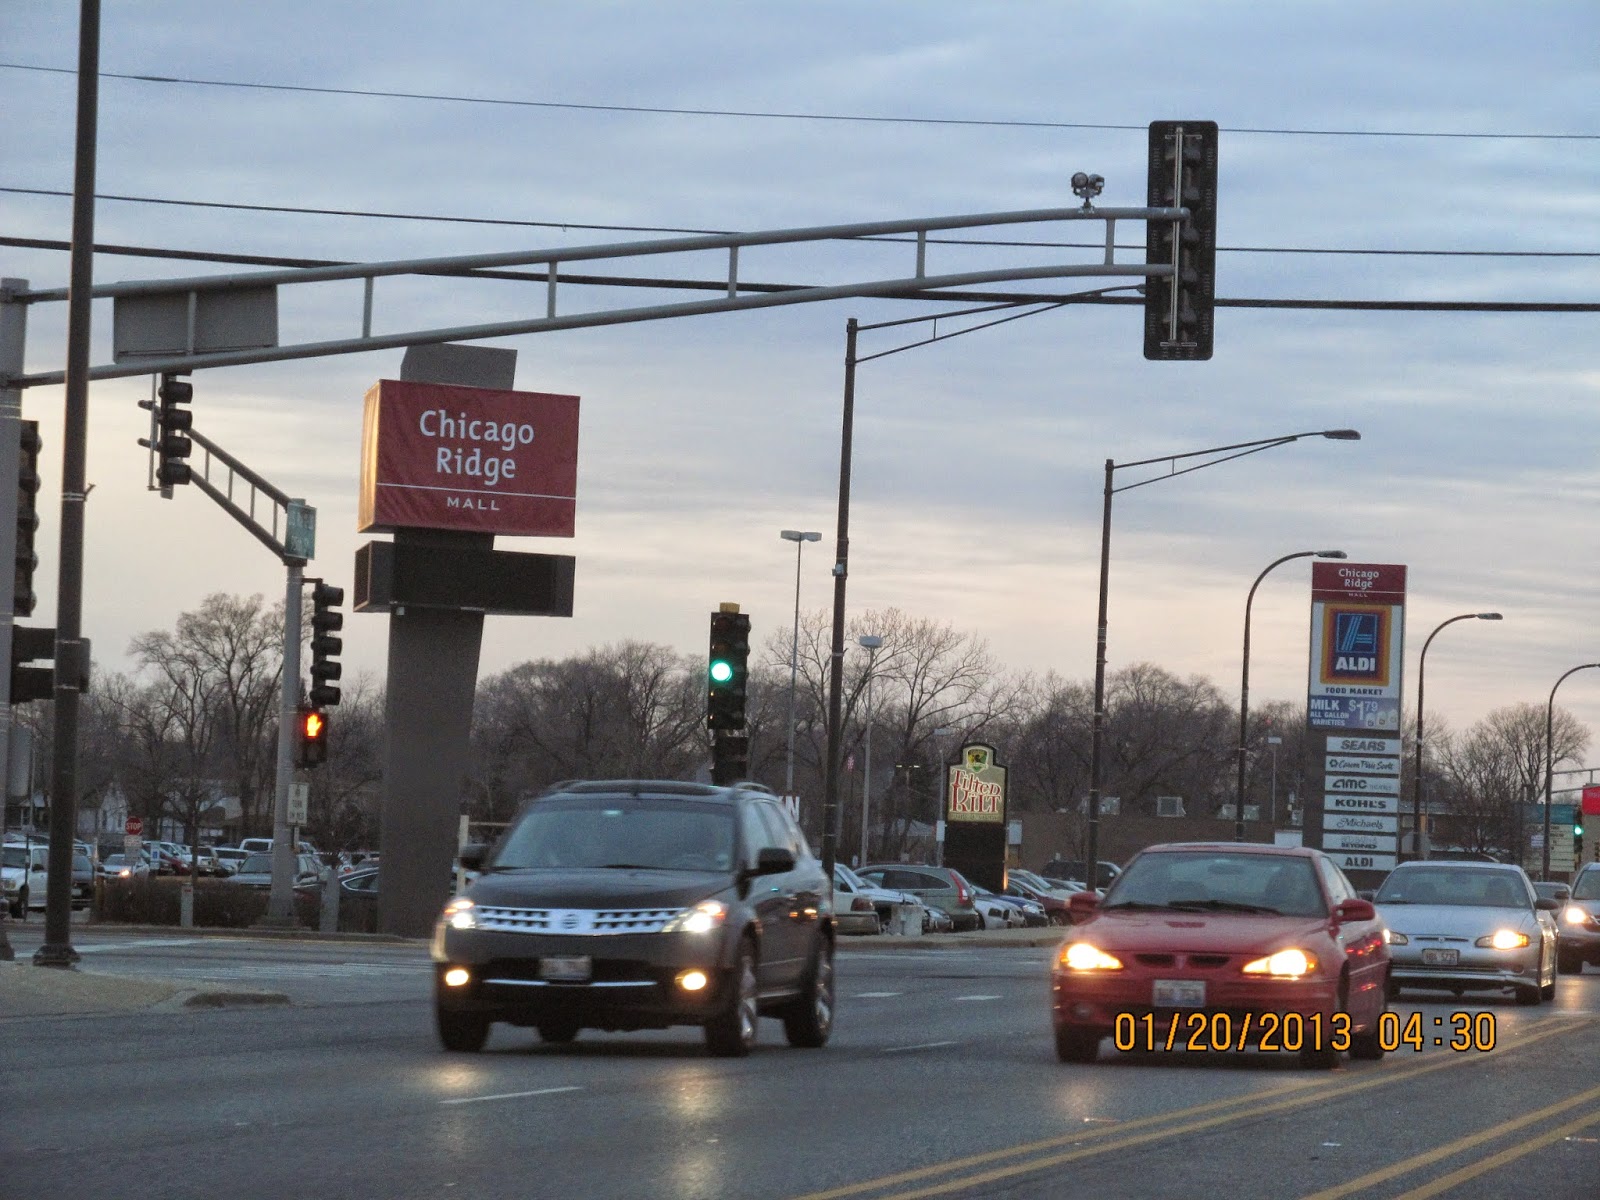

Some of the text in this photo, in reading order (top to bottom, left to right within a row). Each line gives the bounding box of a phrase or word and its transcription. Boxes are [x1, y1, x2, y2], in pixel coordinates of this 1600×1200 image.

[419, 409, 535, 451] Chicago
[436, 447, 516, 486] Ridge
[447, 497, 500, 511] MALL
[1338, 568, 1380, 580] Chicago
[1344, 578, 1373, 590] Ridge
[1335, 656, 1376, 672] ALDI
[1325, 687, 1383, 696] FOOD MARKET
[1310, 699, 1340, 711] MILK
[1310, 710, 1350, 719] ALL GALLON
[1312, 718, 1346, 727] VARIETIES
[1341, 740, 1386, 751] SEARS
[1332, 779, 1367, 789] AMC
[1335, 799, 1387, 809] KOHL'S
[126, 822, 141, 830] STOP
[1336, 817, 1384, 830] Michaels
[1344, 857, 1374, 867] ALDI
